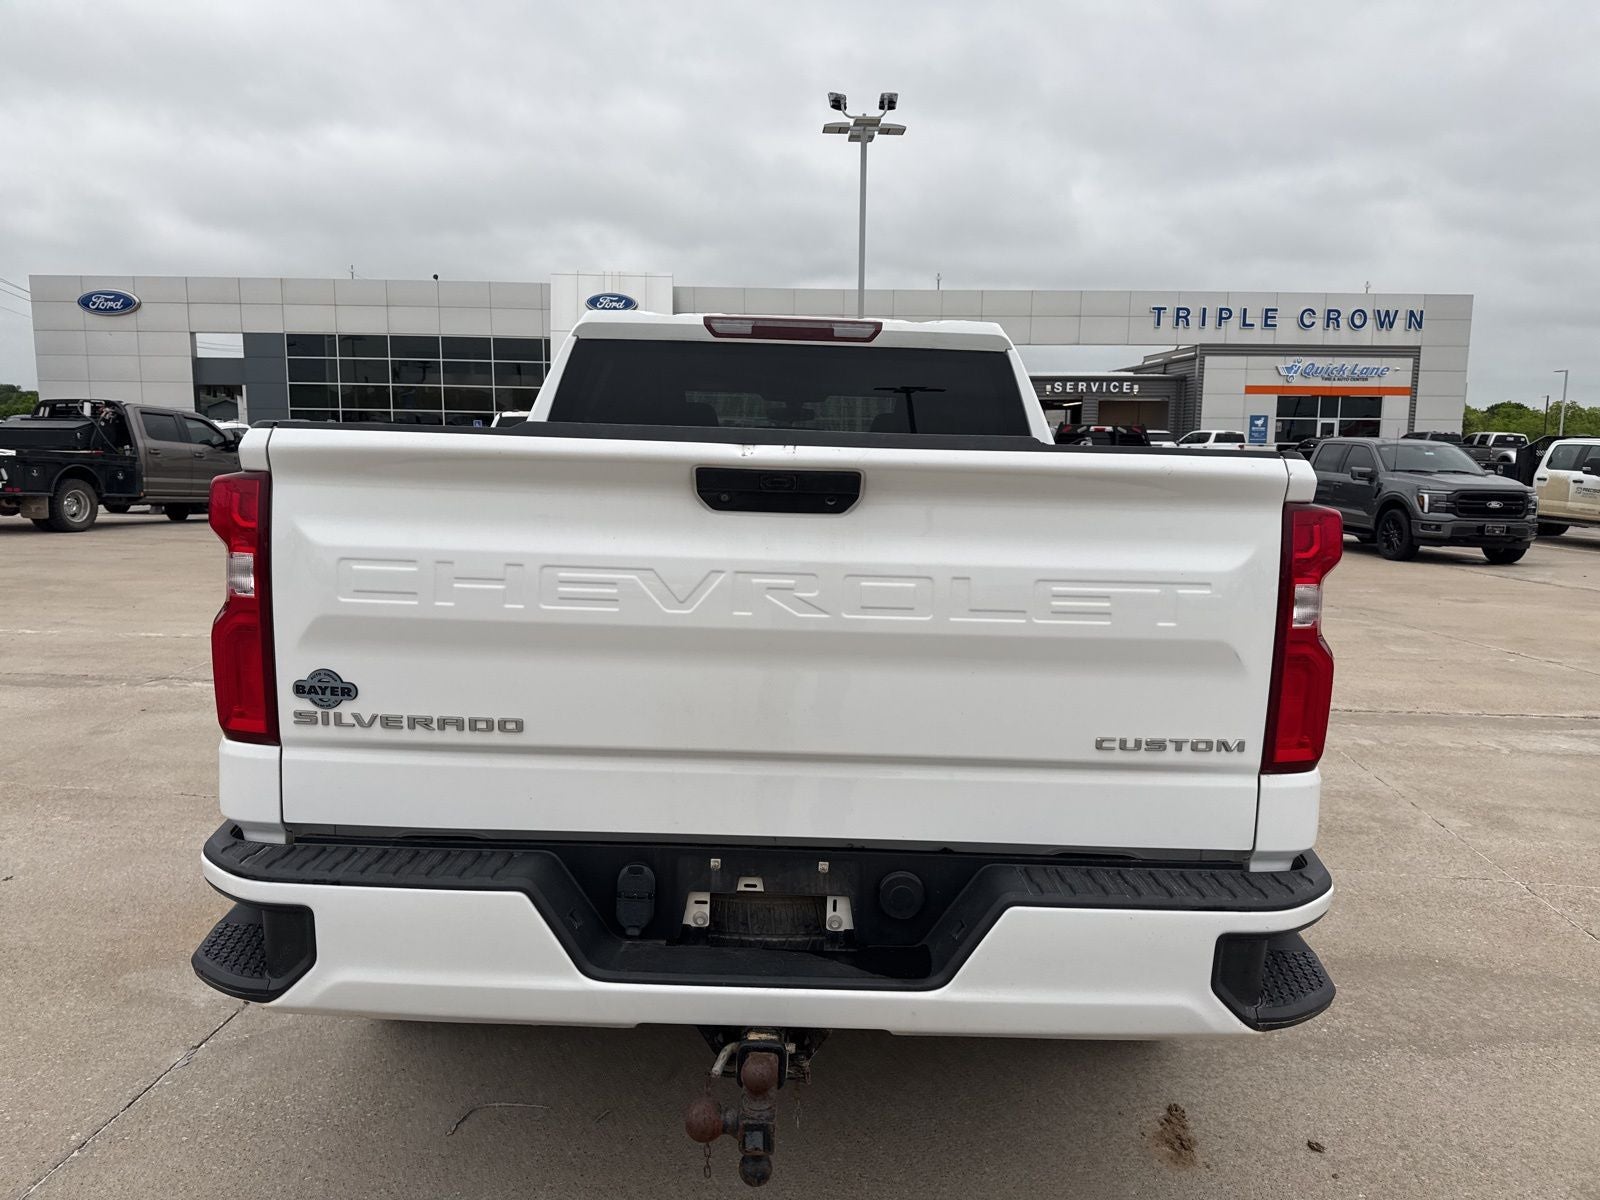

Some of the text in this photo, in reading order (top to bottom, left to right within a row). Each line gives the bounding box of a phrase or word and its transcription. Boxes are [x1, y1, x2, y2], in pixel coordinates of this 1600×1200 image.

[89, 294, 124, 309] Ford
[596, 296, 626, 309] Ford
[1150, 306, 1425, 331] TRIPLE CROWN
[1302, 362, 1391, 378] Quick Lane
[1053, 381, 1132, 393] SERVICE
[337, 557, 1213, 627] CHEVROLET
[295, 684, 353, 698] BAYER
[293, 709, 524, 733] SILVERADO
[1095, 736, 1246, 753] CUSTOM
